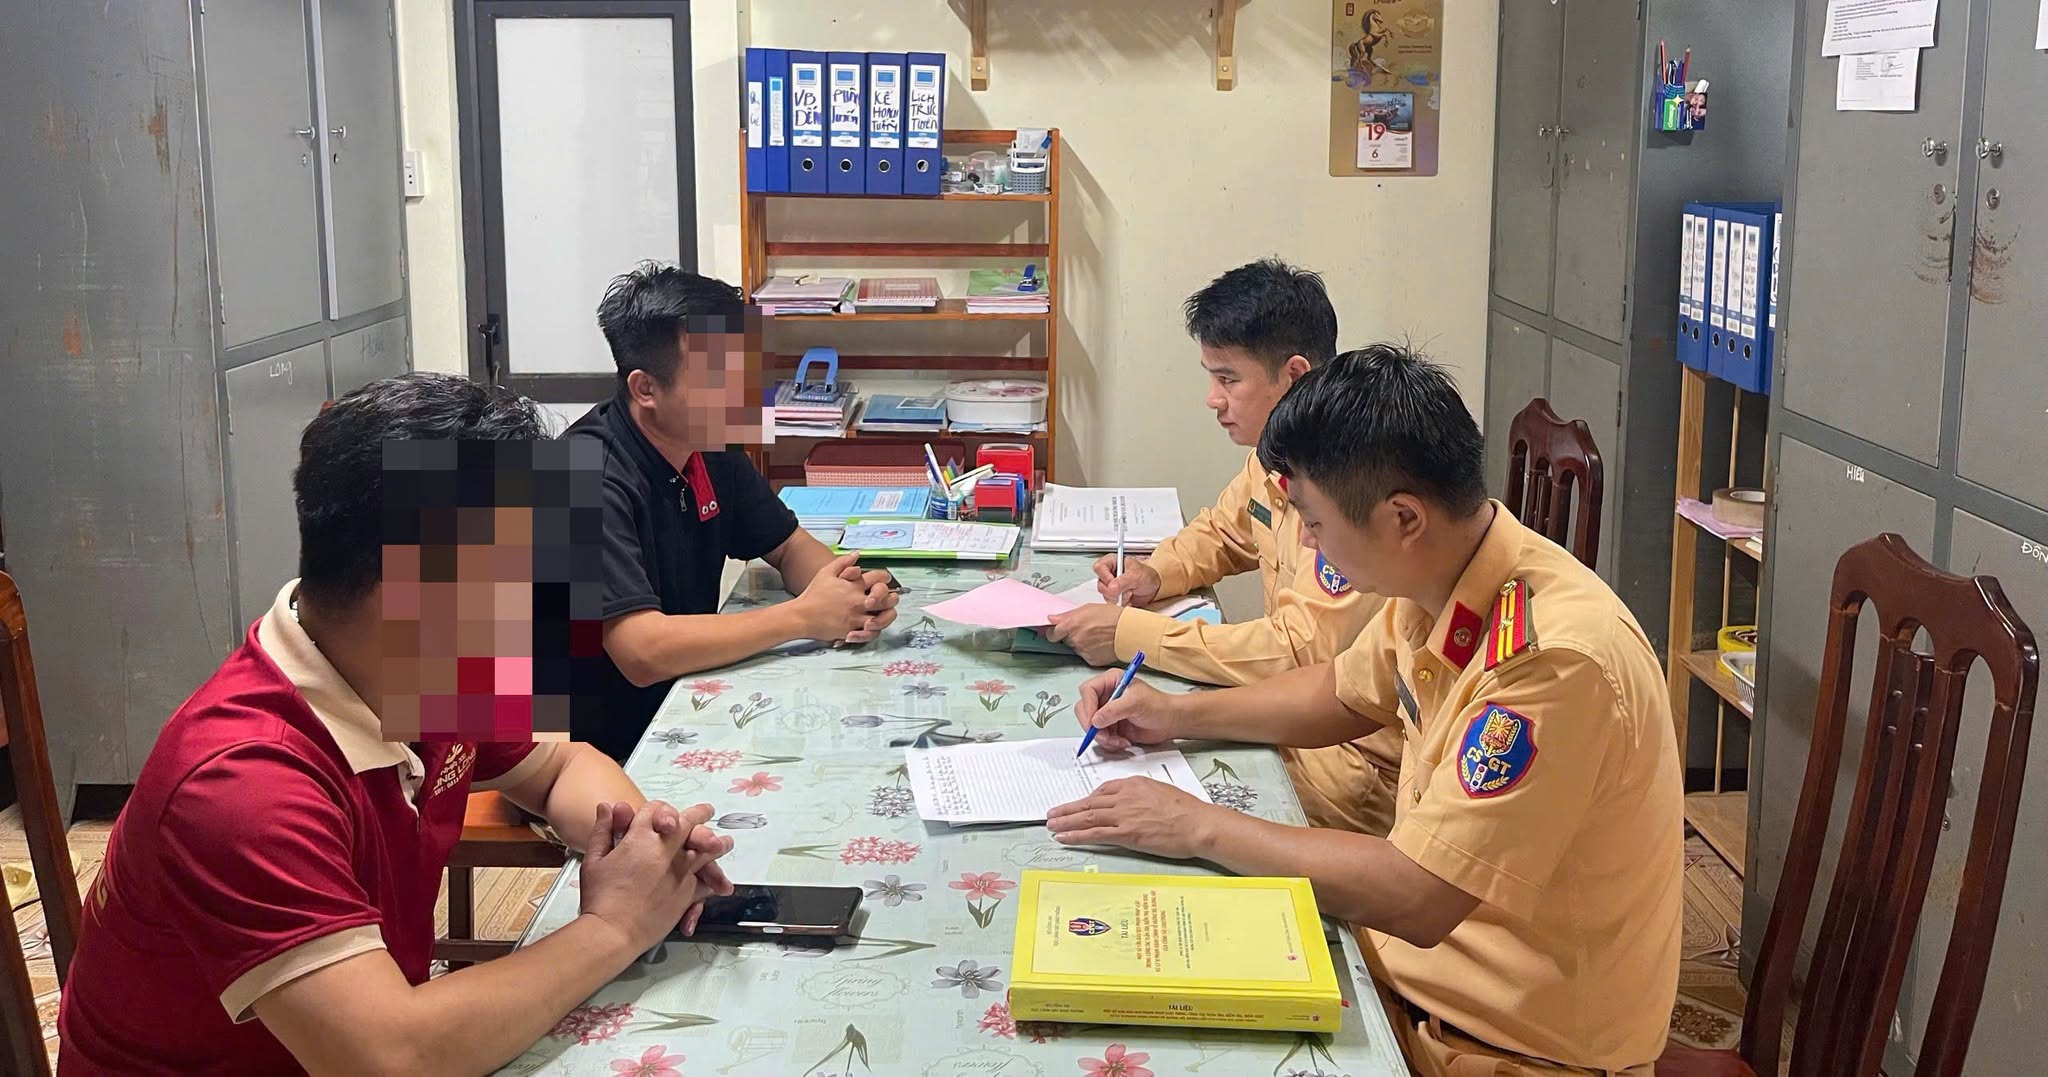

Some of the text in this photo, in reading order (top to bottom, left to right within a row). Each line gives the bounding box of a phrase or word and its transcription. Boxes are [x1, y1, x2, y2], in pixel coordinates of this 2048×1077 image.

[795, 89, 817, 107] VB
[1366, 123, 1386, 141] 19
[1371, 148, 1379, 159] 6
[1322, 564, 1336, 575] CS
[1466, 746, 1484, 763] CS
[1488, 757, 1512, 776] GT
